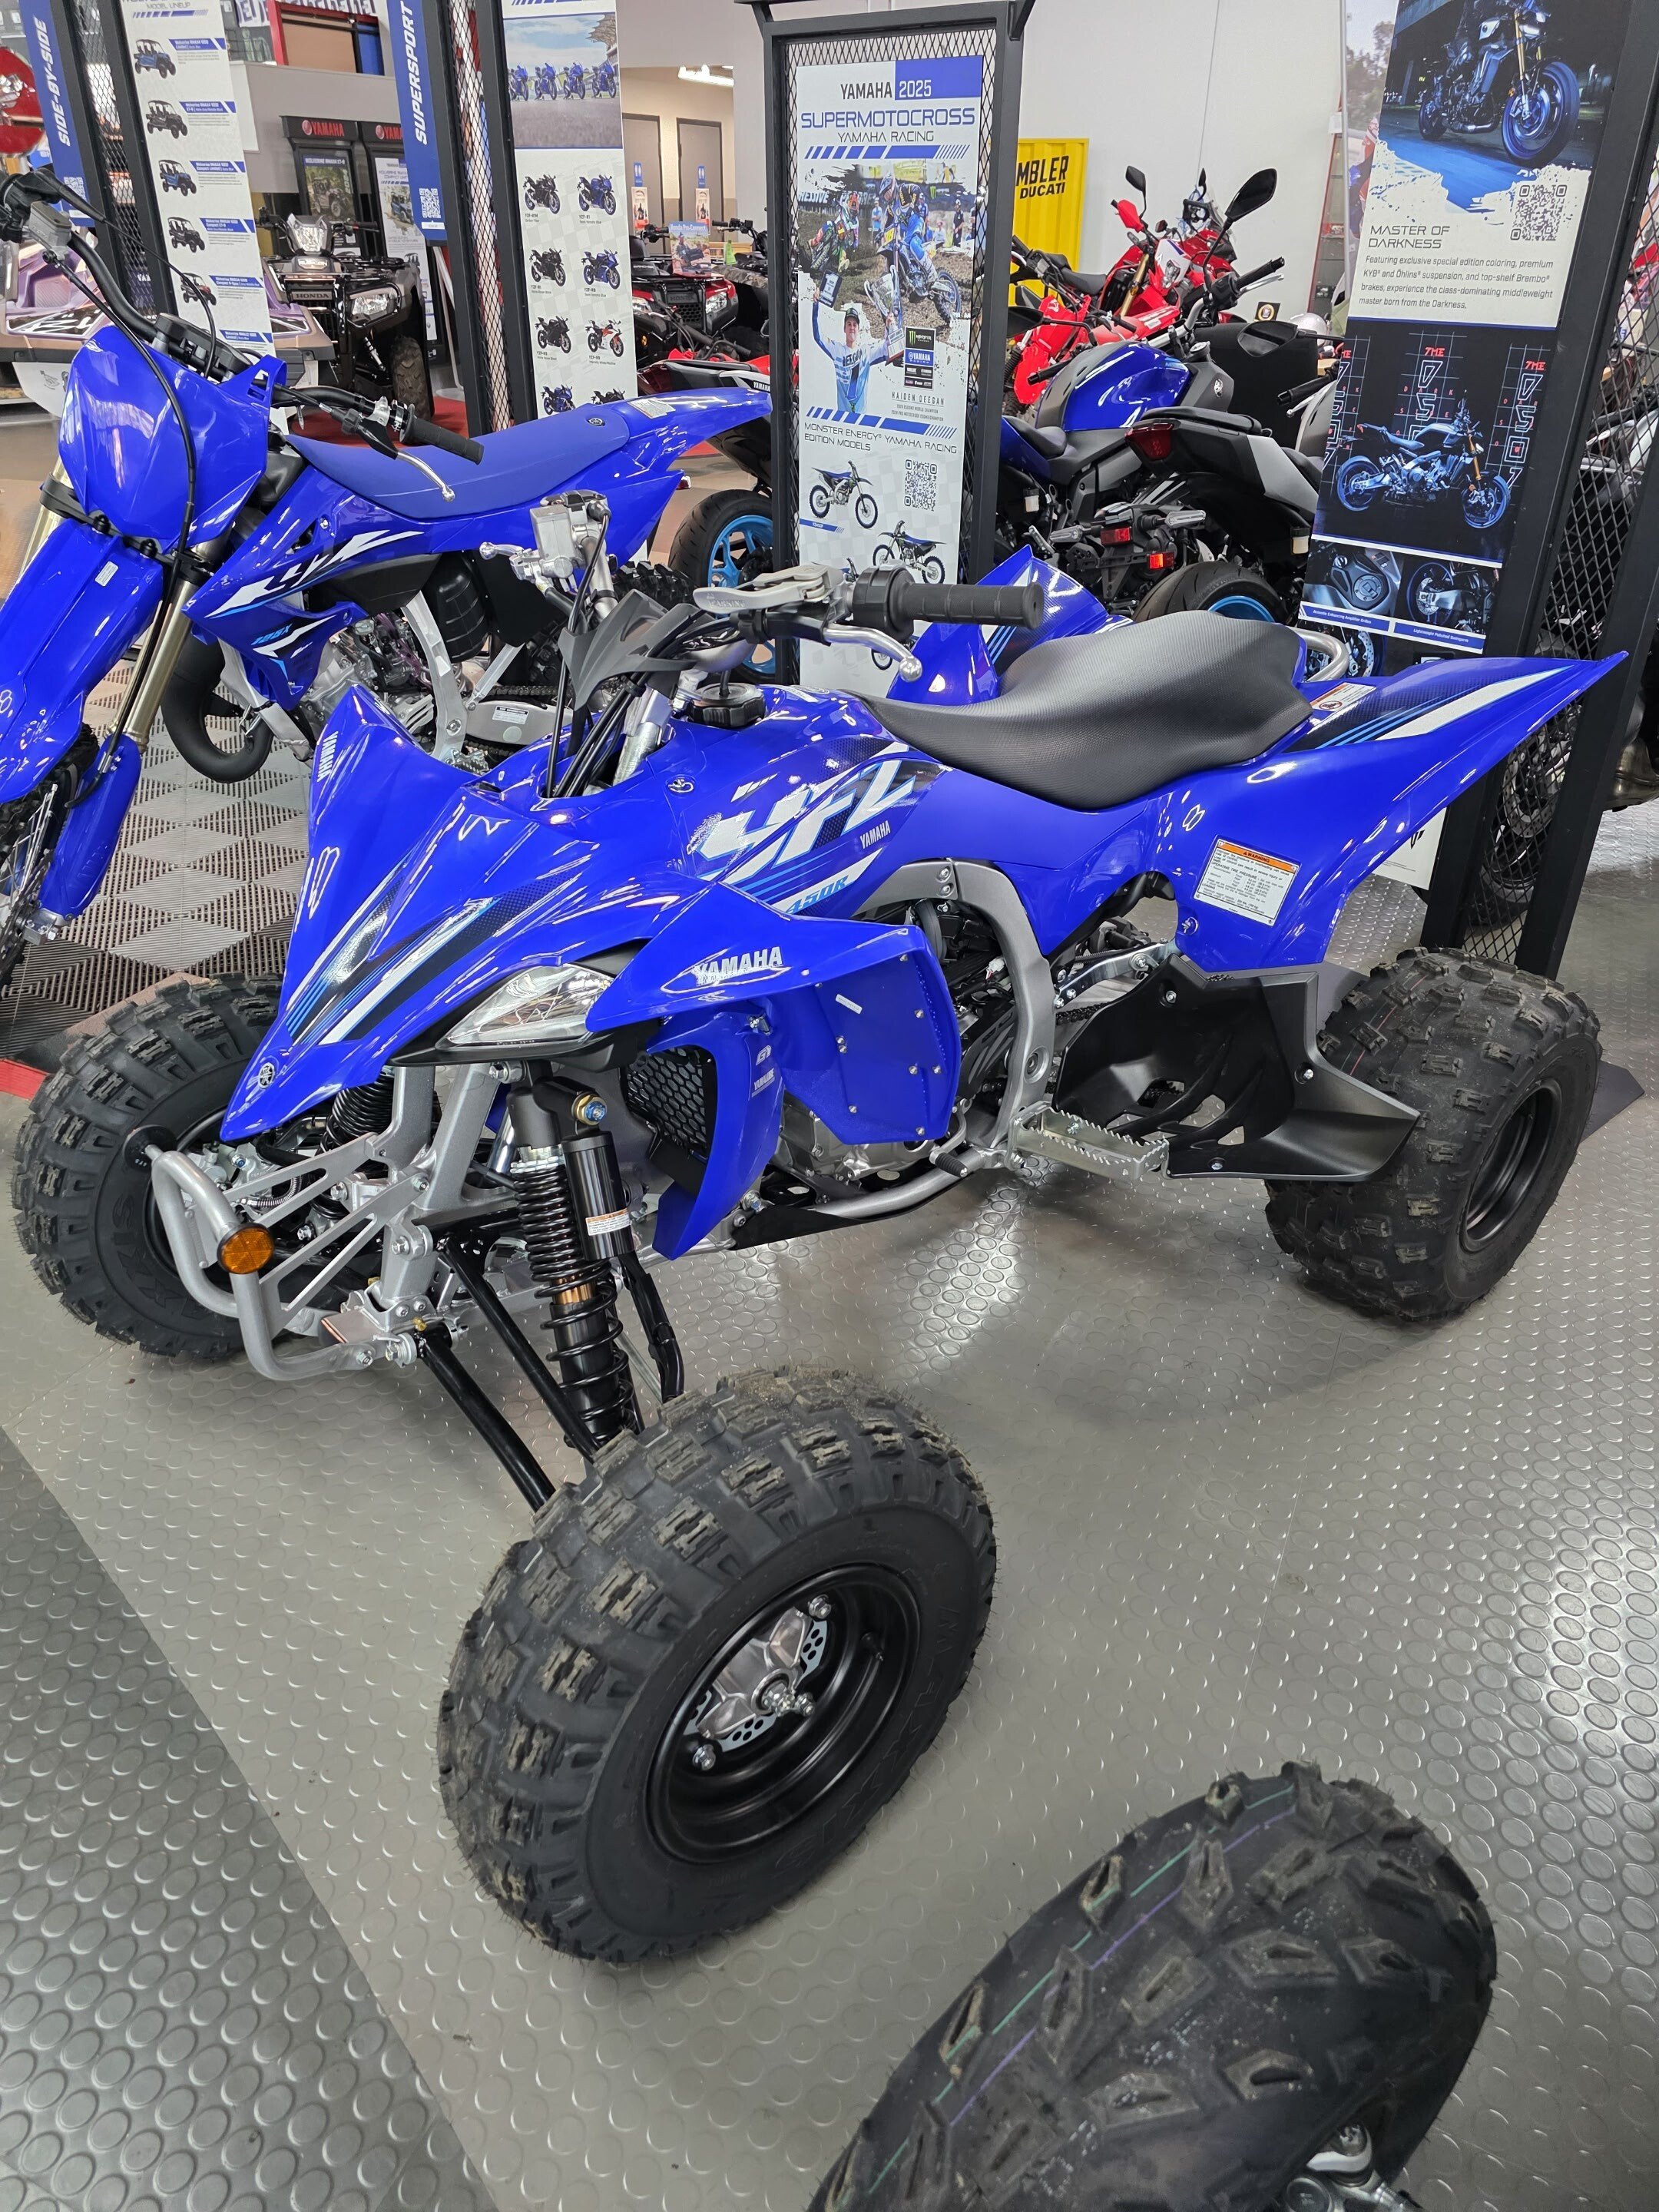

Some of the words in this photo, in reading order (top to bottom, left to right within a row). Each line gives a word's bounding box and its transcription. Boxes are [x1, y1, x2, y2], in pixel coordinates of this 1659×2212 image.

[33, 15, 71, 147] SIDE-BY-SIDE
[396, 1, 428, 145] SUPERSPORT
[840, 81, 892, 100] YAMAHA
[899, 80, 932, 98] 2025
[801, 108, 975, 129] SUPERMOTOCROSS
[312, 122, 344, 136] YAMAHA
[837, 132, 886, 143] YAMAHA
[891, 131, 934, 142] RACING
[1016, 155, 1069, 186] MBLER
[1020, 182, 1065, 199] DUCATI
[1370, 226, 1426, 235] MASTER
[1432, 226, 1450, 235] OF
[1369, 238, 1442, 249] DARKNESS
[1366, 255, 1398, 265] Featuring
[1433, 257, 1458, 266] special
[1486, 259, 1517, 268] coloring,
[1422, 271, 1463, 280] suspension,
[1482, 273, 1515, 282] top-shelf
[1361, 283, 1384, 292] brakes,
[1439, 286, 1501, 297] class-dominating
[1502, 289, 1553, 299] middleweight
[1401, 298, 1417, 306] from
[1432, 300, 1466, 309] Darkness.
[912, 353, 930, 361] YAMAHA
[892, 392, 915, 401] HAIDEN
[919, 395, 944, 406] DEEGAN
[804, 422, 843, 435] MONSTER
[885, 435, 922, 448] YAMAHA
[925, 442, 957, 454] RACING
[804, 433, 834, 445] EDITION
[837, 439, 871, 451] MODELS
[1413, 628, 1434, 637] Lightweight
[317, 731, 339, 782] YAMAHA
[860, 820, 891, 849] YAMAHA
[1247, 853, 1270, 863] WARNING
[785, 876, 849, 913] 450R
[694, 946, 783, 985] YAMAHA
